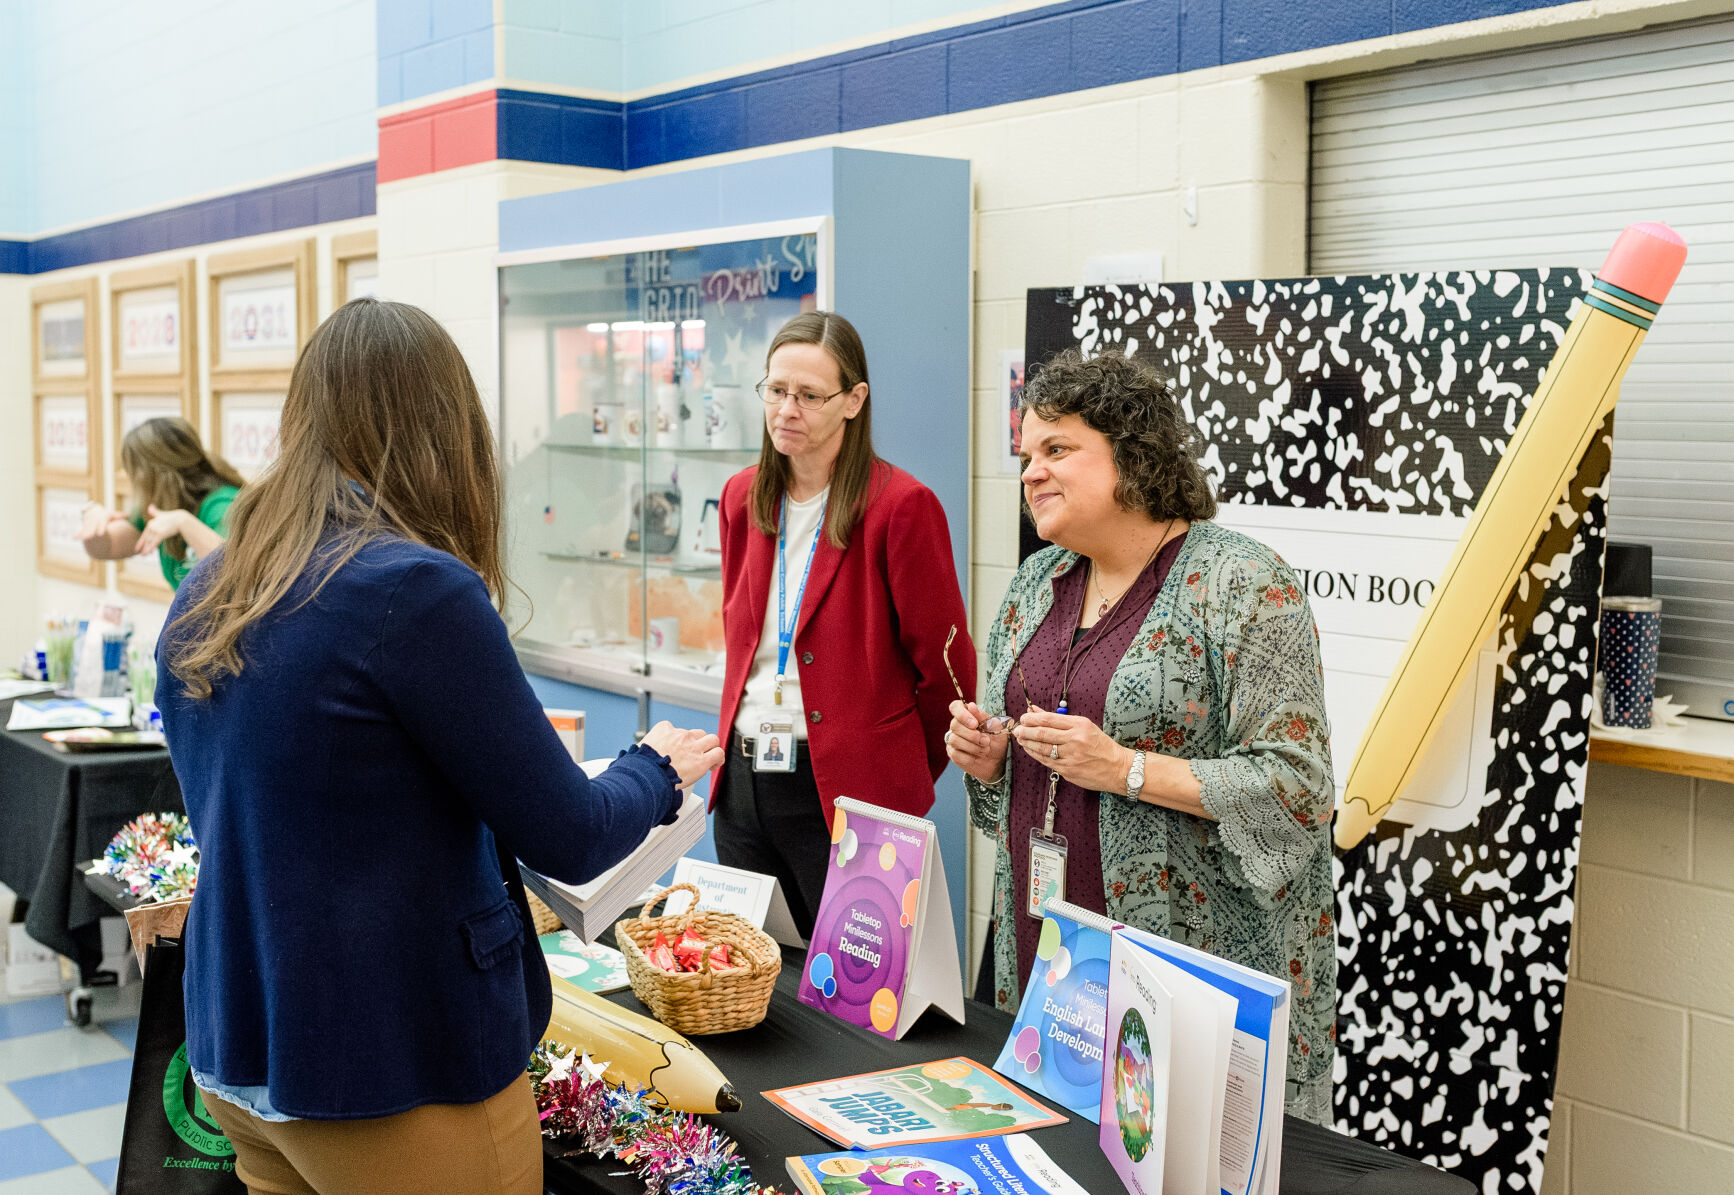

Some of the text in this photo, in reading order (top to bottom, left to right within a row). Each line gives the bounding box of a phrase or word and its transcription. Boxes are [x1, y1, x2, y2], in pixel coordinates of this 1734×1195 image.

[707, 234, 817, 318] Print Sh
[1367, 574, 1435, 608] BOO
[899, 831, 922, 848] Reading
[697, 875, 748, 896] Department
[714, 894, 724, 904] of
[843, 922, 883, 945] Minilessons
[850, 908, 882, 930] Tabletop
[838, 936, 882, 969] Reading
[1074, 993, 1107, 1017] Miniless
[1084, 978, 1108, 999] Tablet
[1135, 974, 1157, 1015] Reading
[1042, 997, 1106, 1039] English Lan
[1048, 1022, 1104, 1062] Developm
[818, 1096, 904, 1136] JUMPS
[850, 1090, 937, 1132] JABARI
[177, 1119, 233, 1152] Public Sc
[163, 1156, 235, 1173] Excellence by
[970, 1154, 1012, 1195] Teacher's Guid
[975, 1143, 1031, 1195] Structured Liter
